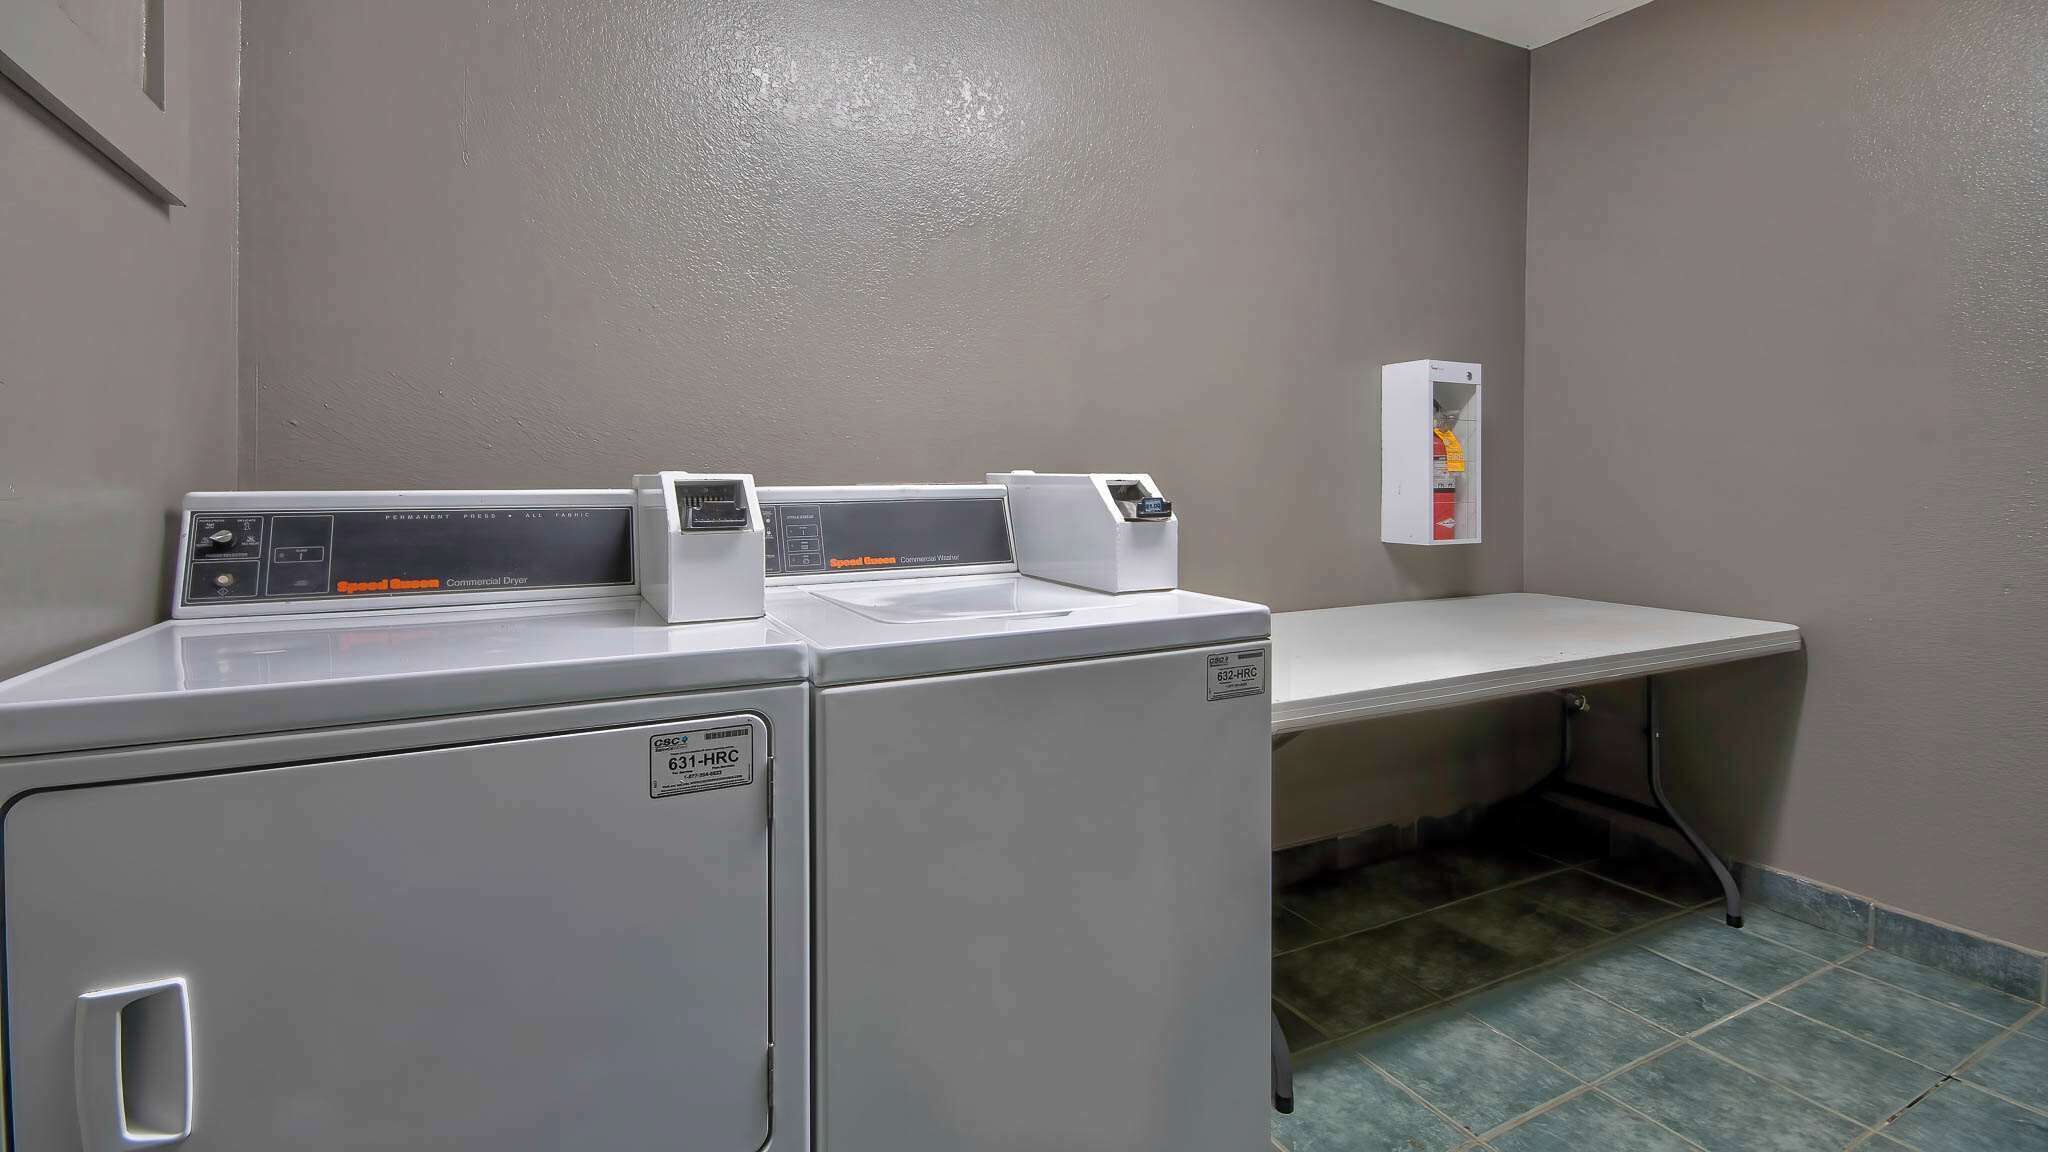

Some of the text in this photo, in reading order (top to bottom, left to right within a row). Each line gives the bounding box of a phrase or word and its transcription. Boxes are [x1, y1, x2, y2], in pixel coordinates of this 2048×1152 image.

[830, 556, 863, 568] Speed
[337, 579, 388, 594] Speed
[446, 577, 501, 587] Commercial
[503, 576, 528, 586] Dryer
[1217, 667, 1258, 682] 632-HRC
[654, 737, 680, 747] CSC
[668, 749, 739, 771] 631-HRC
